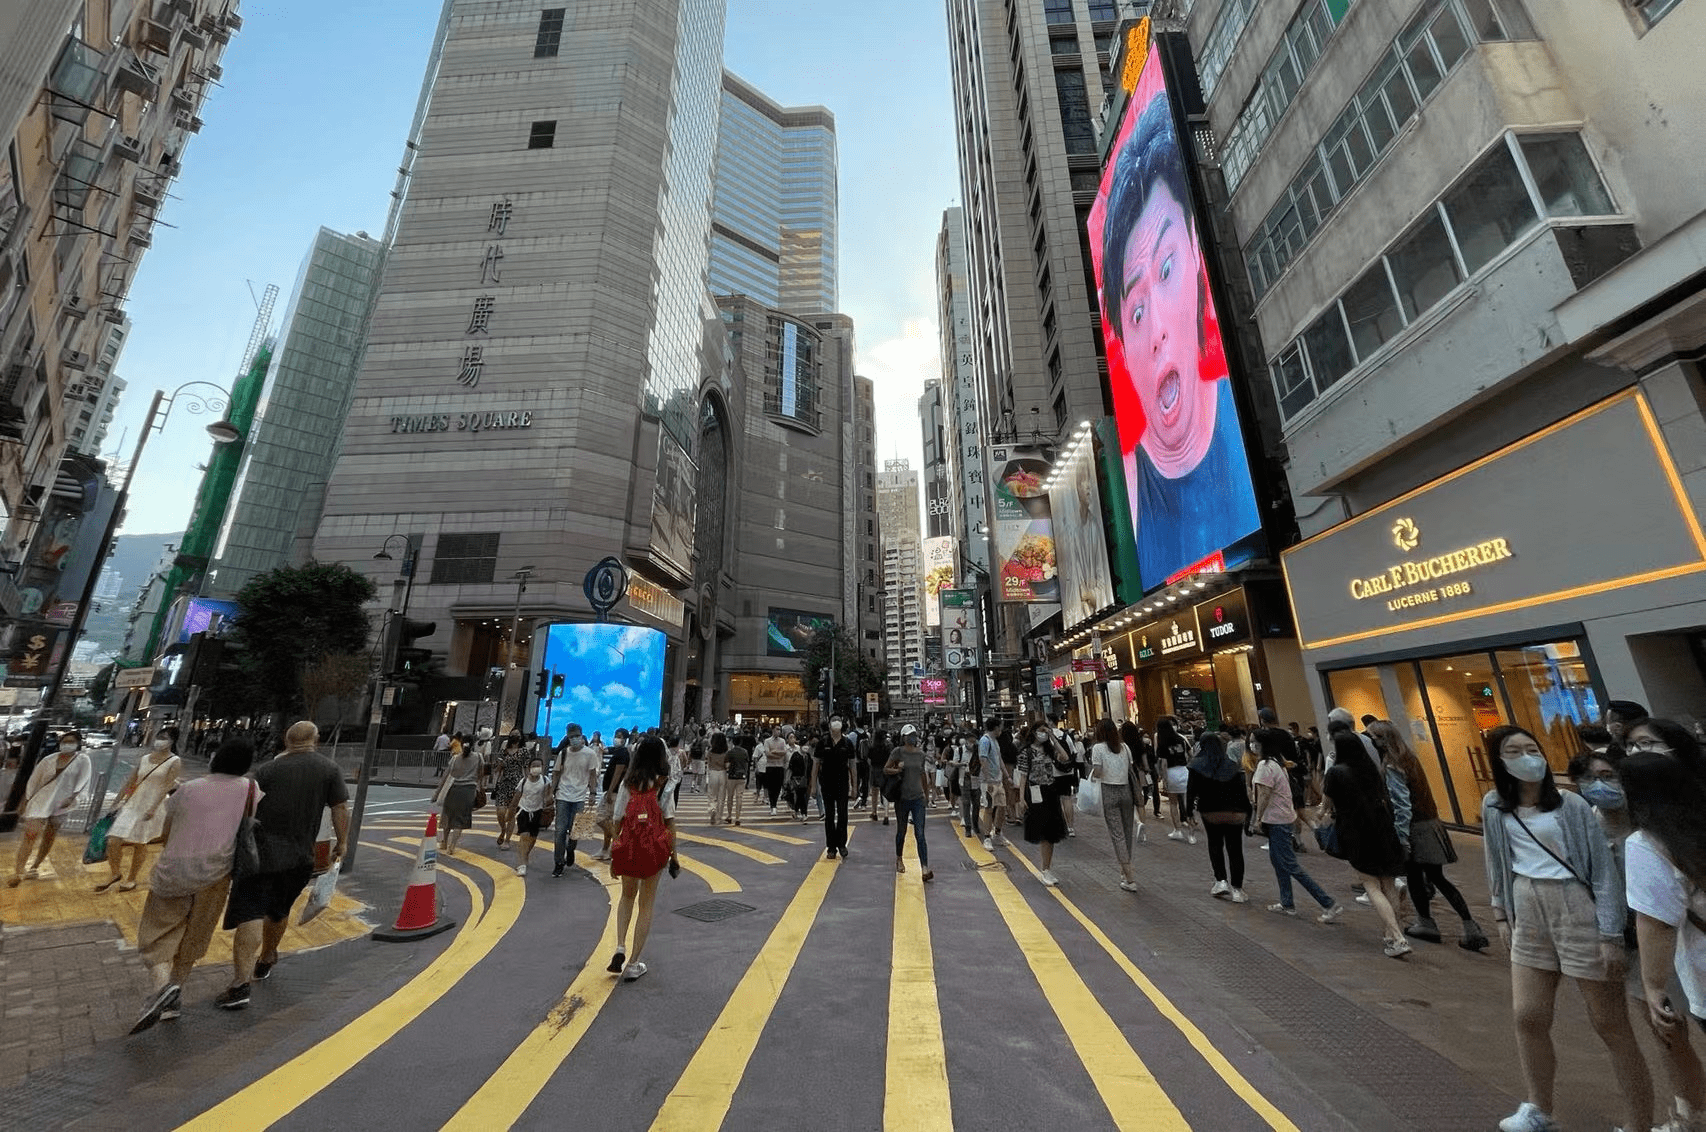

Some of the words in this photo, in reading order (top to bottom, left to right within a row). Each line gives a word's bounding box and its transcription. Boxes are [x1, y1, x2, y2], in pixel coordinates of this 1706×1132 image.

[456, 199, 513, 388] 時代廣場
[391, 414, 449, 433] TIMES
[457, 410, 532, 432] SQUARE
[1351, 574, 1393, 600] CARL
[1404, 537, 1513, 586] BUCHERER
[1387, 590, 1439, 611] LUCERNE
[1440, 581, 1471, 599] 1888
[1210, 623, 1234, 637] TUDOR
